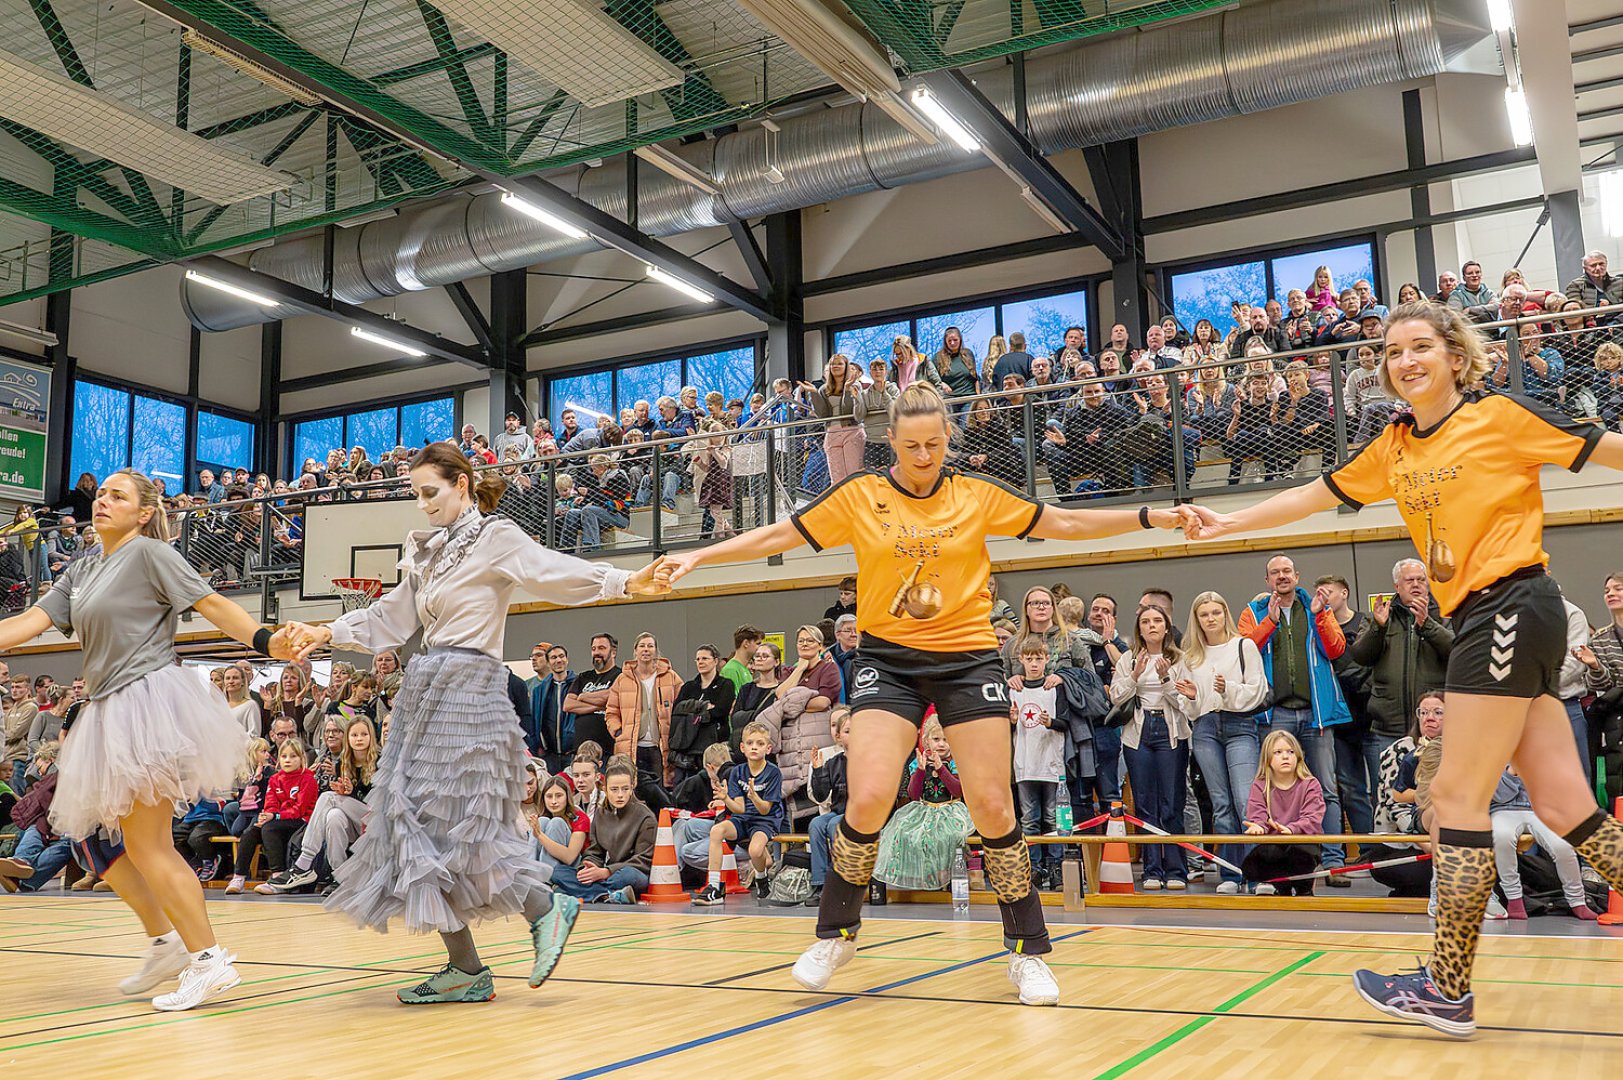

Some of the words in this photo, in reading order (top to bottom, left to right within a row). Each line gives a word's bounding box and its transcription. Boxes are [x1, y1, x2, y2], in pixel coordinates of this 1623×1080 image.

[12, 397, 36, 411] Extra
[0, 446, 26, 459] eude!
[981, 683, 1008, 702] CK
